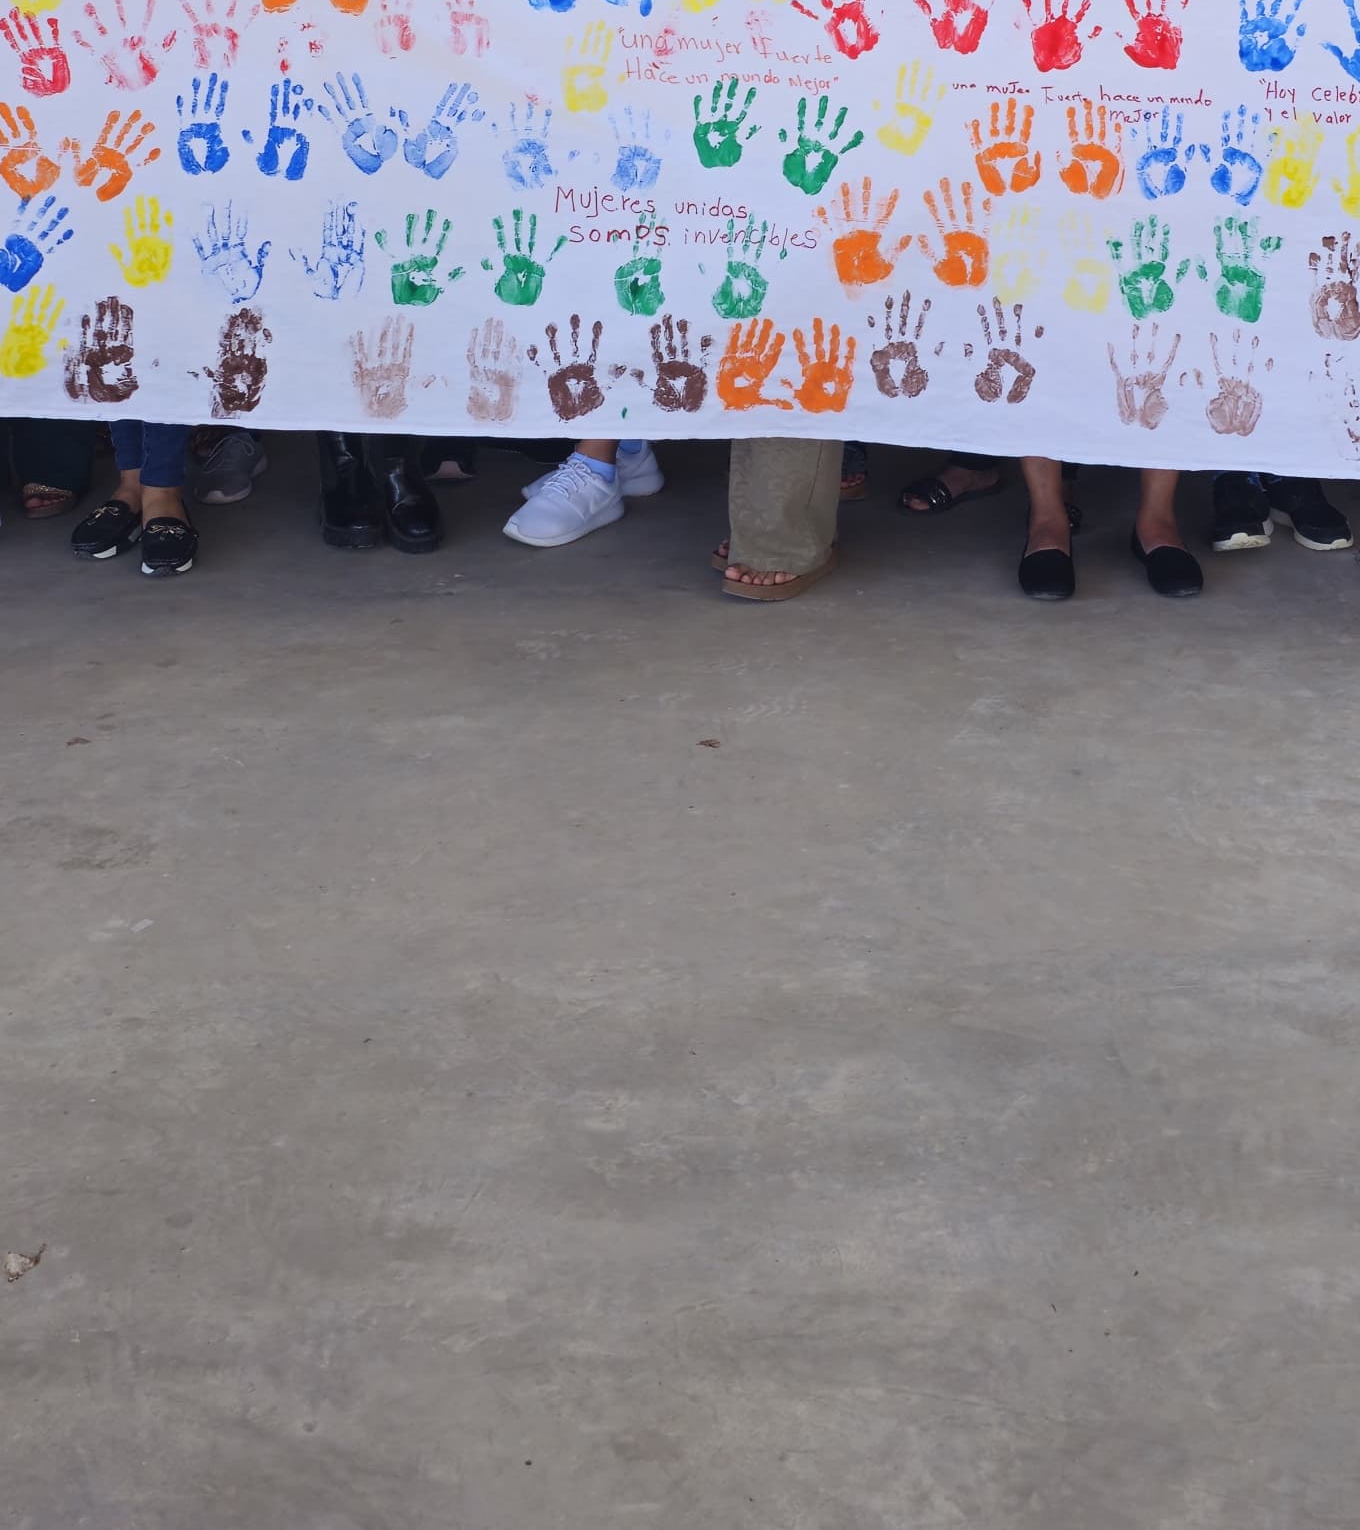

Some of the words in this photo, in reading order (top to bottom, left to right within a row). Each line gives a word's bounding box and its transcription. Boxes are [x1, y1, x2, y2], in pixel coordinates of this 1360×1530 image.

[678, 36, 742, 63] mujer
[685, 72, 709, 84] un
[720, 68, 780, 84] mundo
[951, 82, 977, 91] una
[1099, 84, 1141, 104] hace
[1146, 95, 1165, 105] un
[1280, 107, 1297, 121] el
[553, 185, 656, 218] Mujeres
[674, 197, 748, 220] unidas
[682, 222, 818, 250] invencibles
